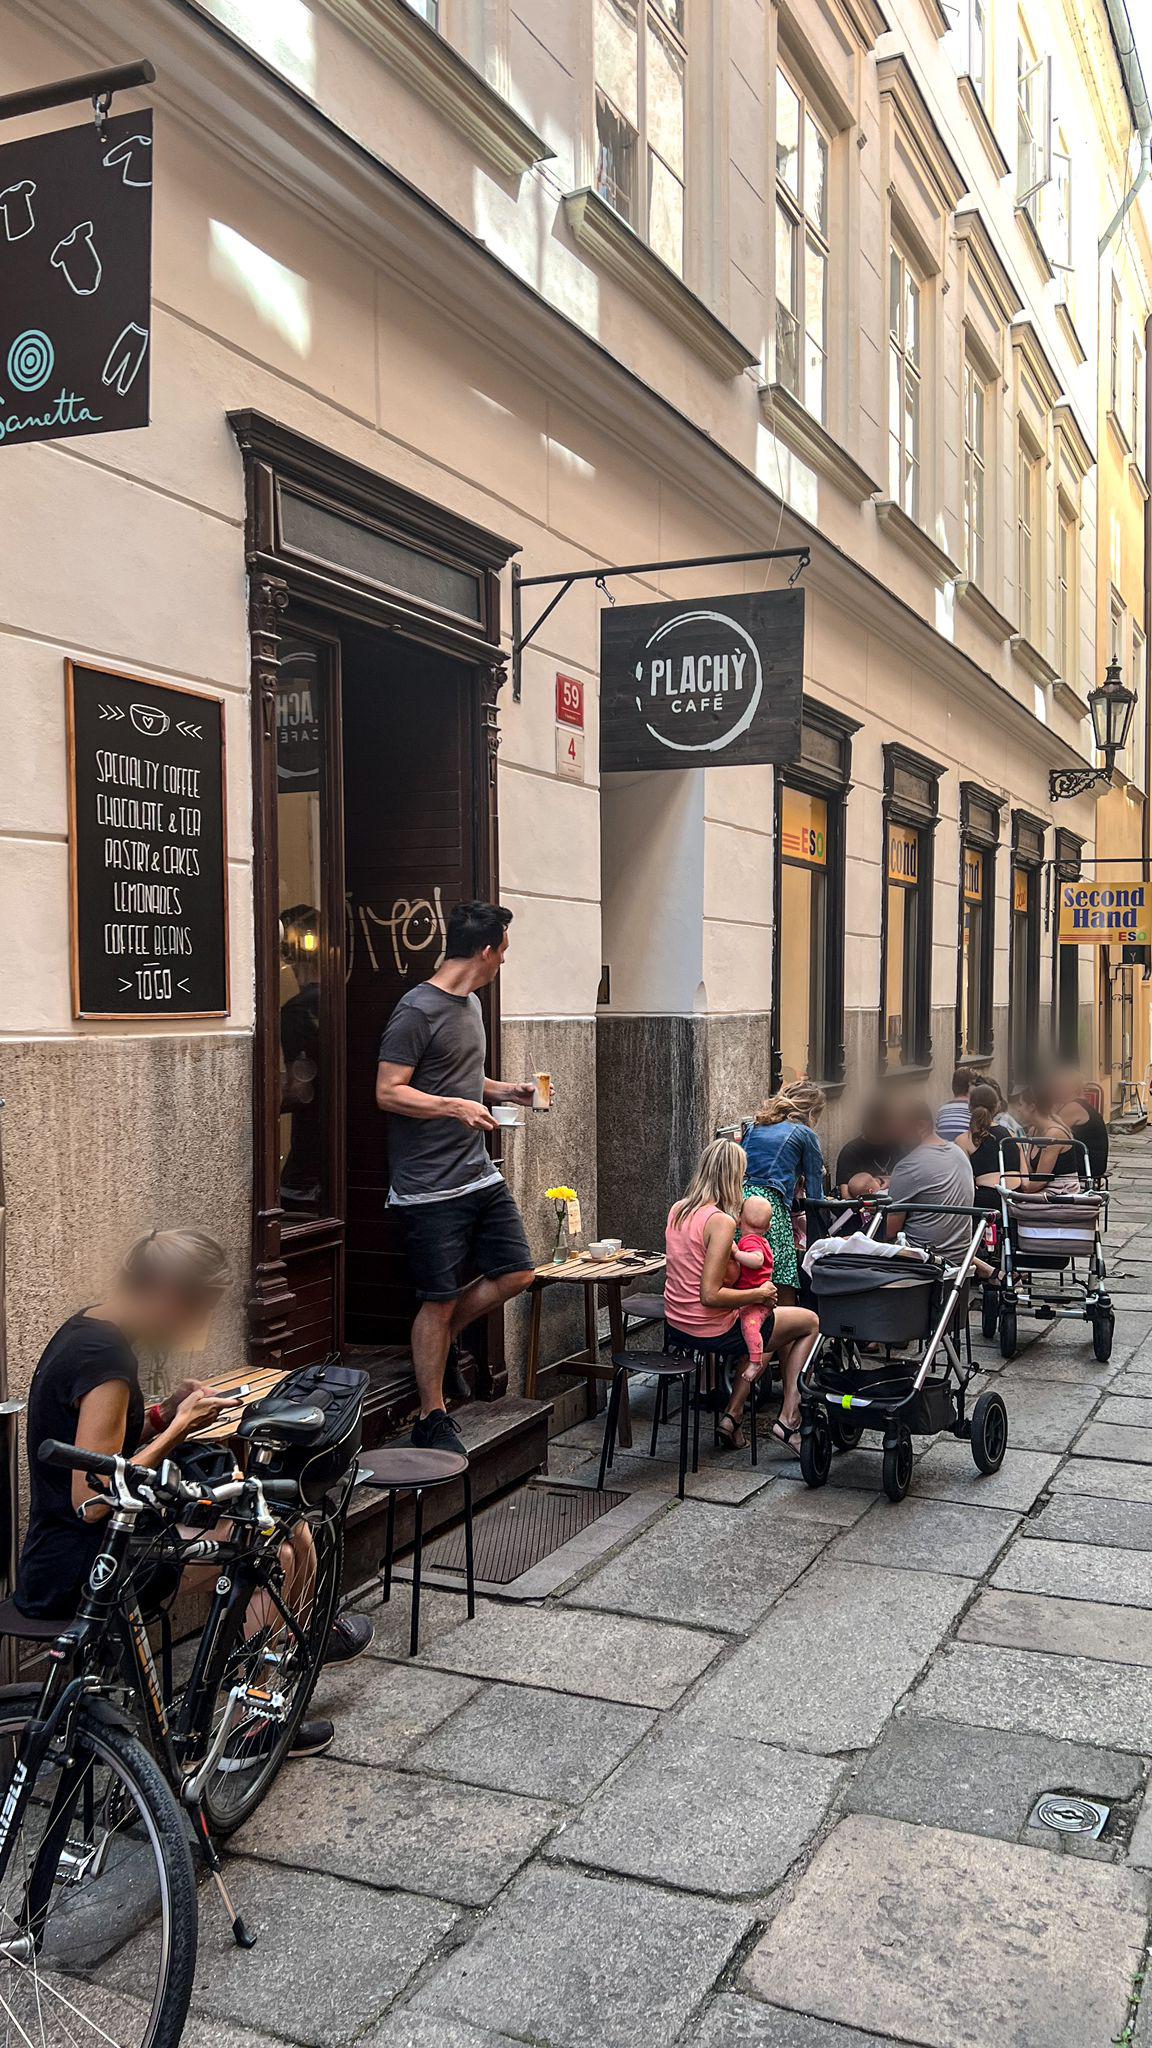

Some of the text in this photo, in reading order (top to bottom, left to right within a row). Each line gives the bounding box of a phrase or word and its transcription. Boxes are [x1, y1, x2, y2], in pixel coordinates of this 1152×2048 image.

[563, 681, 580, 709] 59
[671, 693, 723, 714] CAFÉ
[567, 737, 577, 761] 4
[95, 749, 201, 799] SPECIALTY COFFEE
[96, 793, 201, 837] CHOCOLATE & TEA
[104, 838, 200, 876] PASTRY & CAKES
[801, 827, 825, 858] ESO
[114, 881, 182, 915] LEMONADES
[1064, 887, 1145, 908] Second
[1072, 908, 1138, 928] Hand
[104, 923, 193, 956] COFFEE BEANS
[1118, 931, 1148, 942] ESO
